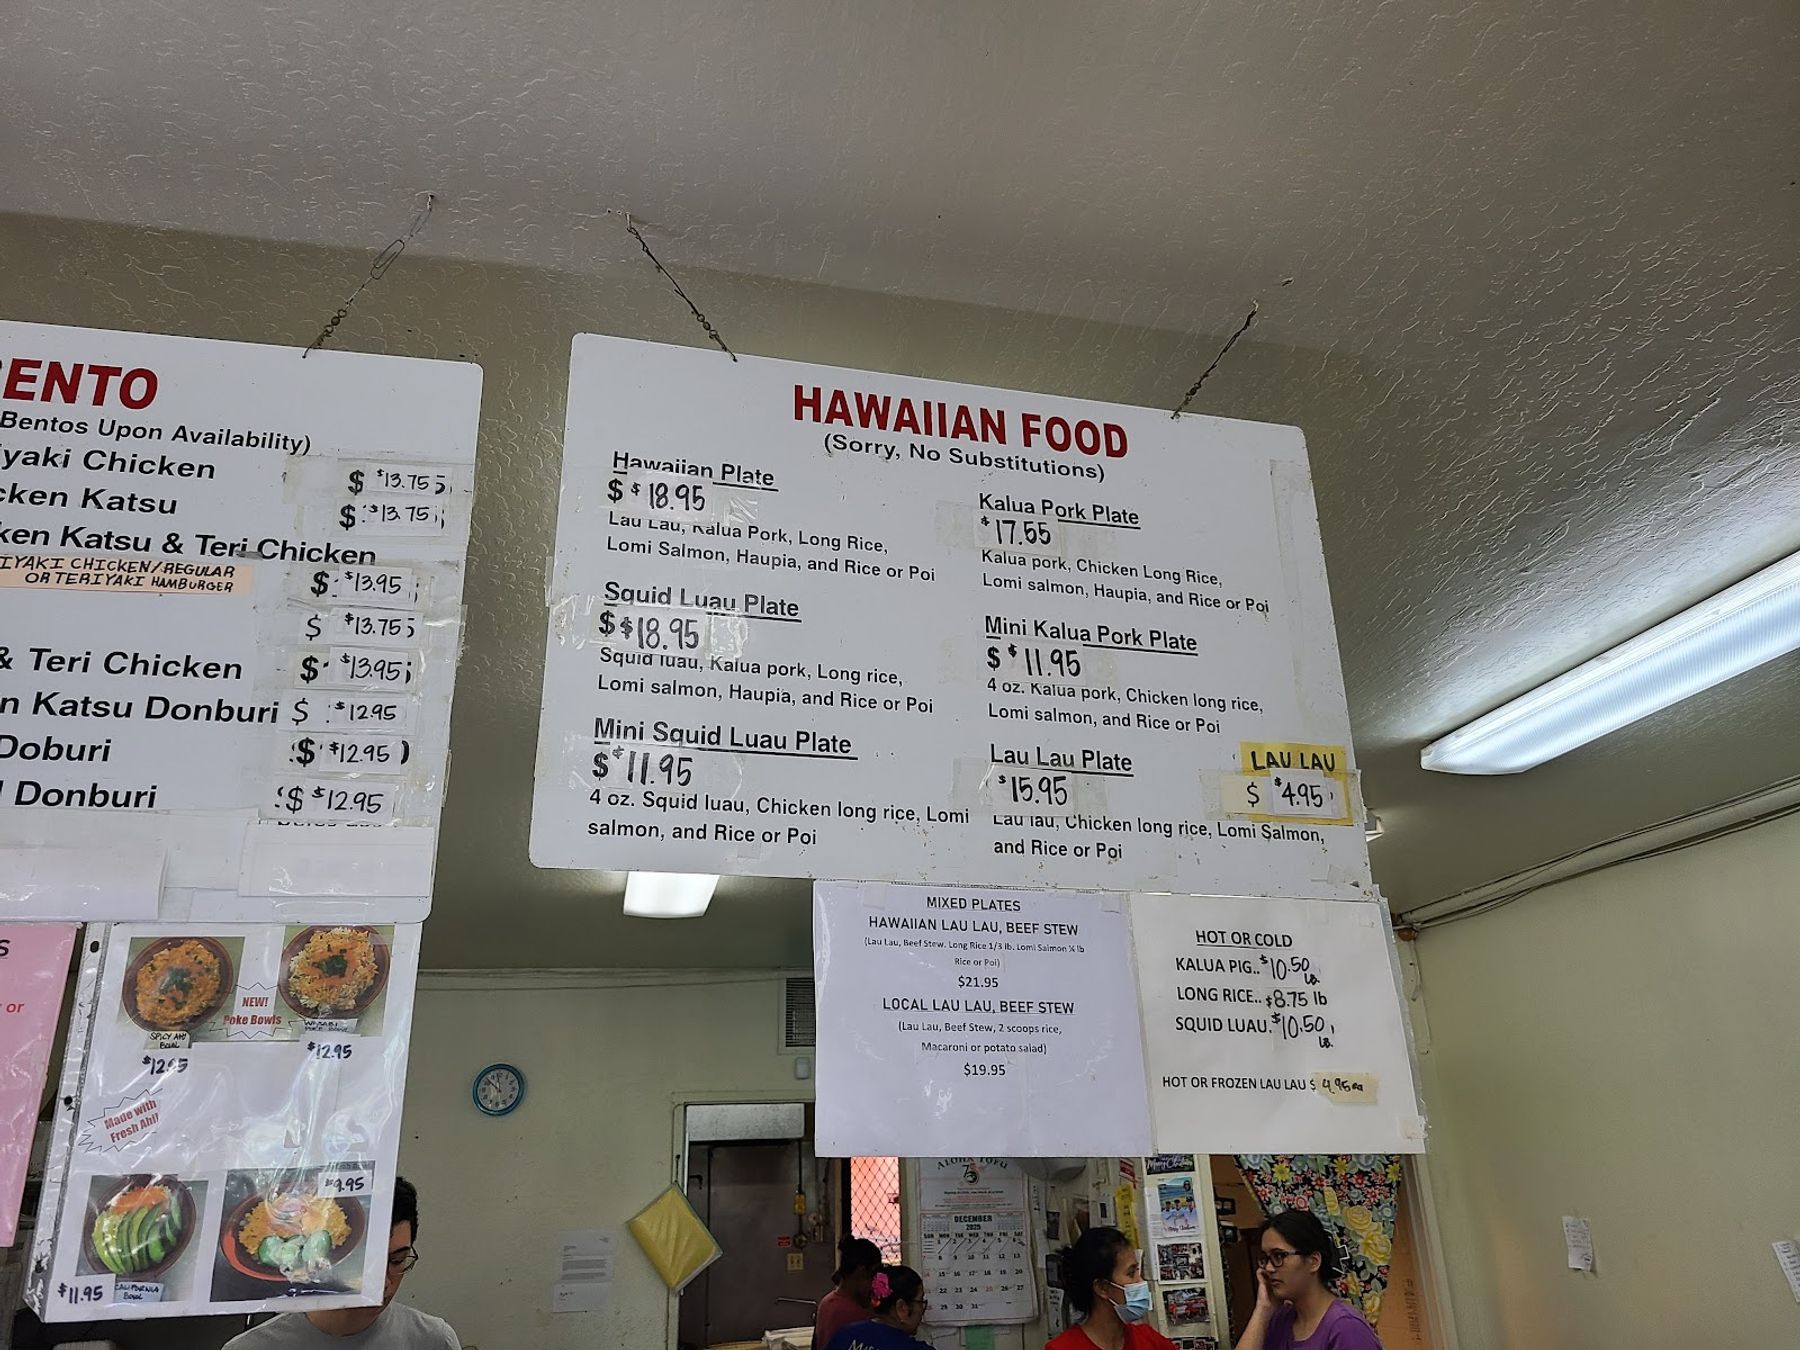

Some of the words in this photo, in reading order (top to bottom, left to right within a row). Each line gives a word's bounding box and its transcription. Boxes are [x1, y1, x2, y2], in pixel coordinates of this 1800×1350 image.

[0, 358, 158, 410] ENTO
[794, 384, 1006, 446] HAWAIIAN
[1022, 412, 1129, 458] FOOD
[0, 411, 88, 434] Bentos
[99, 419, 162, 442] Upon
[171, 425, 310, 456] Availability)
[0, 446, 72, 470] yaki
[83, 449, 216, 479] Chicken
[612, 451, 713, 478] Hawaiian
[721, 463, 775, 487] Plate
[824, 434, 901, 462] (Sorry,
[909, 443, 940, 462] No
[949, 447, 1106, 483] Substitutions)
[81, 488, 177, 514] Katsu
[980, 493, 1035, 515] Kalua
[1041, 500, 1086, 520] Pork
[1092, 505, 1139, 525] Plate
[60, 526, 151, 552] Katsu
[162, 533, 184, 554] &
[195, 534, 247, 558] Teri
[257, 538, 376, 565] Chicken
[607, 536, 652, 554] Lomi
[658, 541, 731, 564] Salmon,
[736, 549, 801, 571] Haupia,
[807, 557, 838, 573] and
[845, 560, 882, 577] Rice
[886, 566, 903, 579] or
[909, 565, 936, 582] Poi
[981, 550, 1027, 567] Kalua
[1031, 556, 1072, 573] pork,
[1076, 558, 1139, 578] Chicken
[1143, 565, 1181, 585] Long
[1186, 569, 1223, 588] Rice,
[25, 572, 51, 584] OR
[56, 571, 146, 587] TERIYAKI
[151, 576, 233, 592] HAMBURGER
[983, 573, 1022, 590] Lomi
[1028, 578, 1090, 599] salmon,
[1094, 584, 1151, 604] Haupia,
[1156, 589, 1183, 606] and
[1189, 592, 1221, 609] Rice
[1226, 597, 1241, 610] or
[1246, 597, 1269, 613] Poi
[605, 581, 672, 607] Squid
[680, 588, 736, 610] Luau
[744, 594, 800, 617] Plate
[985, 615, 1027, 636] Mini
[1034, 620, 1092, 643] Kalua
[1098, 626, 1143, 647] Pork
[1150, 630, 1198, 652] Plate
[29, 647, 92, 673] Teri
[103, 651, 242, 680] Chicken
[32, 691, 133, 718] Katsu
[145, 696, 278, 724] Donburi
[594, 717, 645, 741] Mini
[653, 721, 721, 749] Squid
[730, 727, 787, 751] Luau
[796, 730, 853, 754] Plate
[991, 743, 1029, 766] Lau
[1037, 746, 1075, 768] Lau
[1082, 749, 1132, 773] Plate
[1251, 751, 1291, 771] LAU
[1300, 752, 1336, 772] LAU
[15, 780, 157, 808] Donburi
[997, 773, 1068, 807] $15.95
[1274, 776, 1324, 808] $4.95
[927, 896, 967, 910] MIXED
[972, 897, 1021, 912] PLATES
[869, 916, 937, 931] HAWAIIAN
[941, 918, 968, 932] LAU
[973, 919, 1002, 935] LAU,
[1006, 922, 1039, 935] BEEF
[1044, 923, 1078, 936] STEW
[864, 937, 883, 948] (Lau
[884, 938, 901, 948] Lau,
[903, 939, 922, 948] Beef
[948, 940, 968, 951] Long
[970, 940, 987, 950] Rice
[989, 941, 1003, 951] 1/3
[1017, 942, 1035, 952] Lomi
[1195, 930, 1227, 944] HOT
[1231, 931, 1251, 945] OR
[1255, 933, 1293, 948] COLD
[954, 957, 971, 967] Rice
[973, 959, 982, 967] or
[984, 958, 1000, 968] Poi)
[1175, 957, 1225, 973] KALUA
[958, 976, 999, 989] $21.95
[242, 996, 268, 1008] NEW!
[883, 998, 928, 1011] LOCAL
[932, 999, 960, 1012] LAU
[965, 1000, 996, 1015] LAU,
[1000, 1001, 1034, 1013] BEEF
[1038, 1002, 1074, 1014] STEW
[1177, 987, 1218, 1001] LONG
[1265, 989, 1308, 1009] $8.75
[1314, 992, 1328, 1006] lb
[223, 1015, 248, 1026] Poke
[250, 1014, 282, 1026] Bowls
[898, 1021, 919, 1032] (Lau
[921, 1021, 942, 1033] Lau,
[944, 1022, 967, 1032] Beef
[969, 1022, 996, 1034] Stew,
[998, 1023, 1004, 1033] 2
[1006, 1025, 1040, 1036] scoops
[1041, 1025, 1062, 1036] rice,
[1175, 1016, 1223, 1032] SQUID
[306, 1042, 353, 1060] $12.95
[921, 1042, 968, 1053] Macaroni
[971, 1044, 982, 1053] or
[984, 1043, 1016, 1055] potato
[1018, 1043, 1047, 1056] salad)
[964, 1063, 1006, 1077] $19.95
[1163, 1076, 1190, 1088] HOT
[1191, 1077, 1209, 1089] OR
[1211, 1077, 1257, 1090] FROZEN
[1260, 1078, 1281, 1090] LAU
[1284, 1078, 1307, 1091] LAU
[104, 1110, 134, 1130] Made
[134, 1100, 157, 1117] with
[110, 1124, 139, 1144] Fresh
[954, 1215, 993, 1223] DECEMBER
[57, 1282, 103, 1304] $11.95
